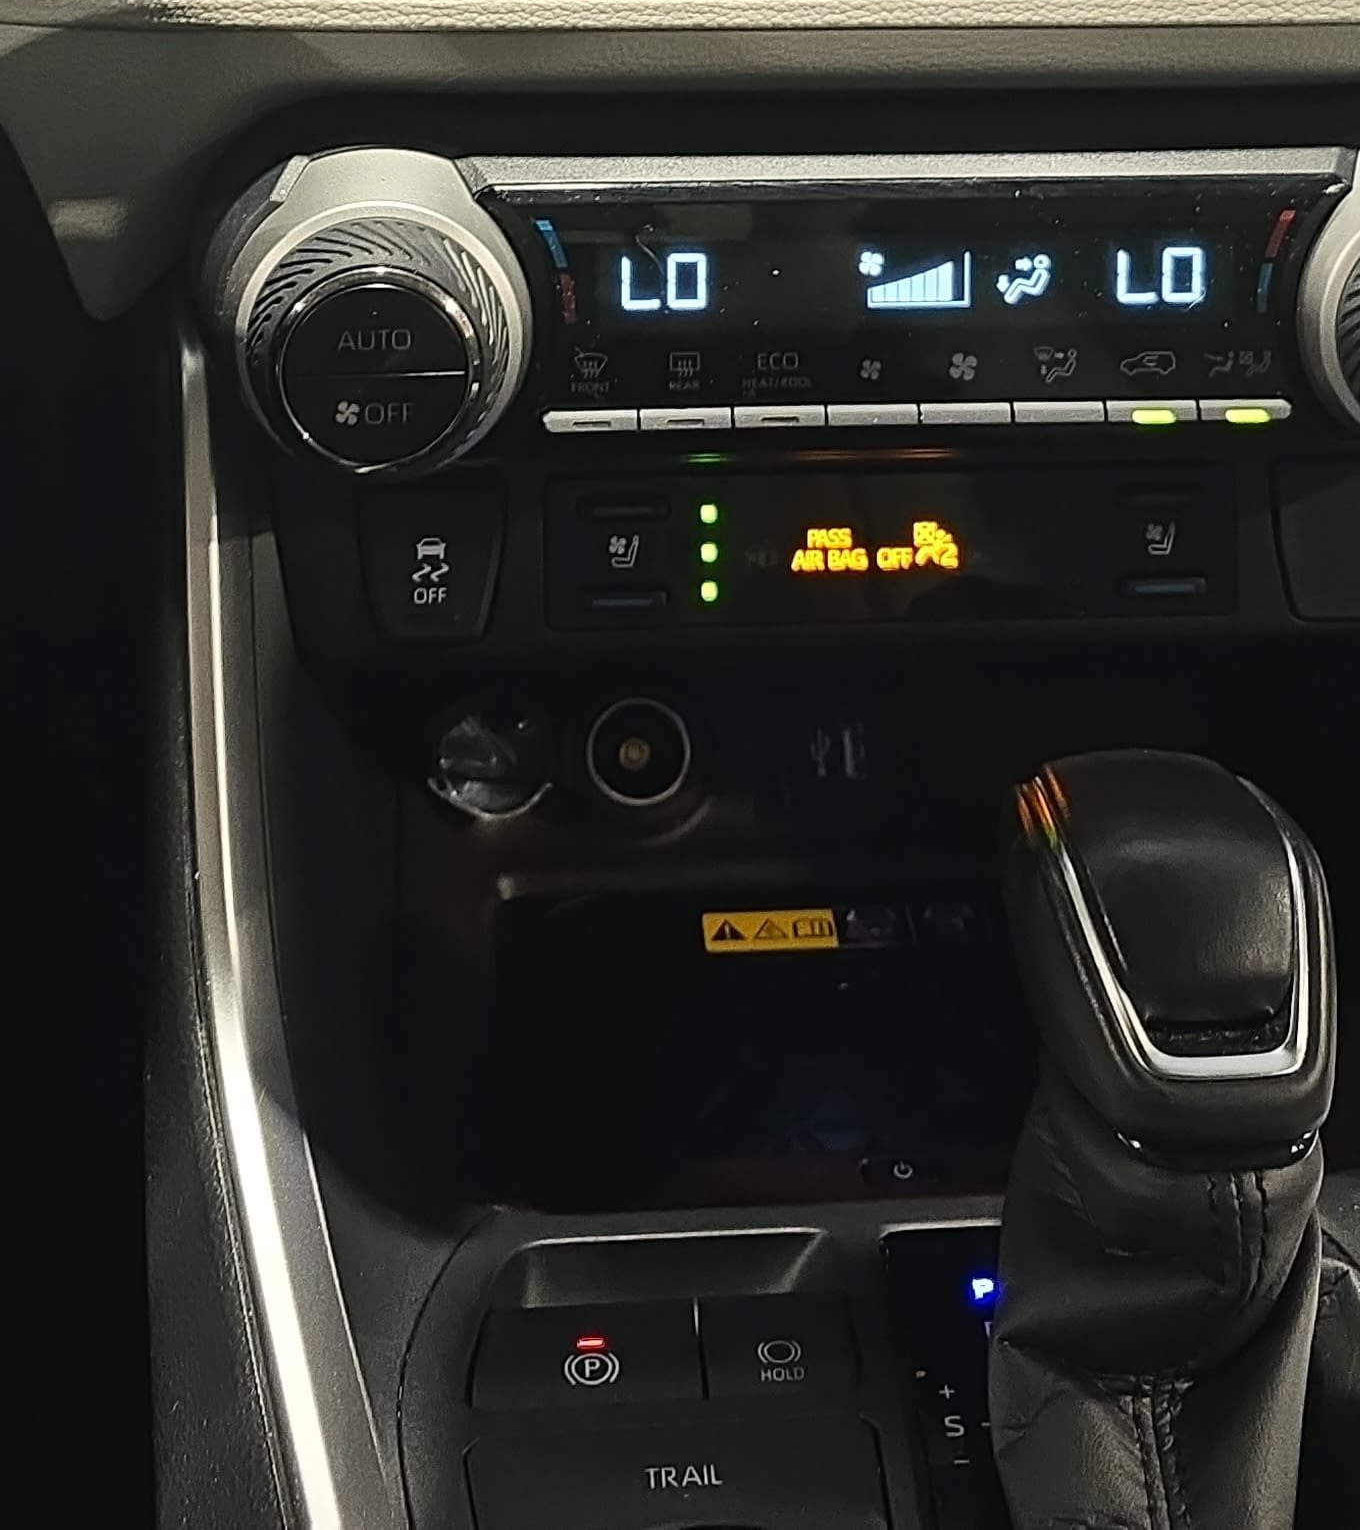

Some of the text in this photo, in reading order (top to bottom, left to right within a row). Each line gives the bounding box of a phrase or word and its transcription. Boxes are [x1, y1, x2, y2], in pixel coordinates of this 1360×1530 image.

[337, 328, 411, 352] AUTO
[757, 352, 799, 371] ECO
[570, 380, 609, 394] FRONT
[668, 380, 701, 391] REAR
[364, 401, 415, 427] OFF
[807, 528, 853, 549] PASS
[791, 549, 825, 571] AIR
[828, 548, 869, 572] BAG
[876, 547, 913, 571] OFF
[413, 587, 448, 606] OFF
[971, 1277, 995, 1300] P
[760, 1366, 806, 1382] HOLD
[943, 1414, 966, 1439] S
[644, 1465, 724, 1490] TRAIL
